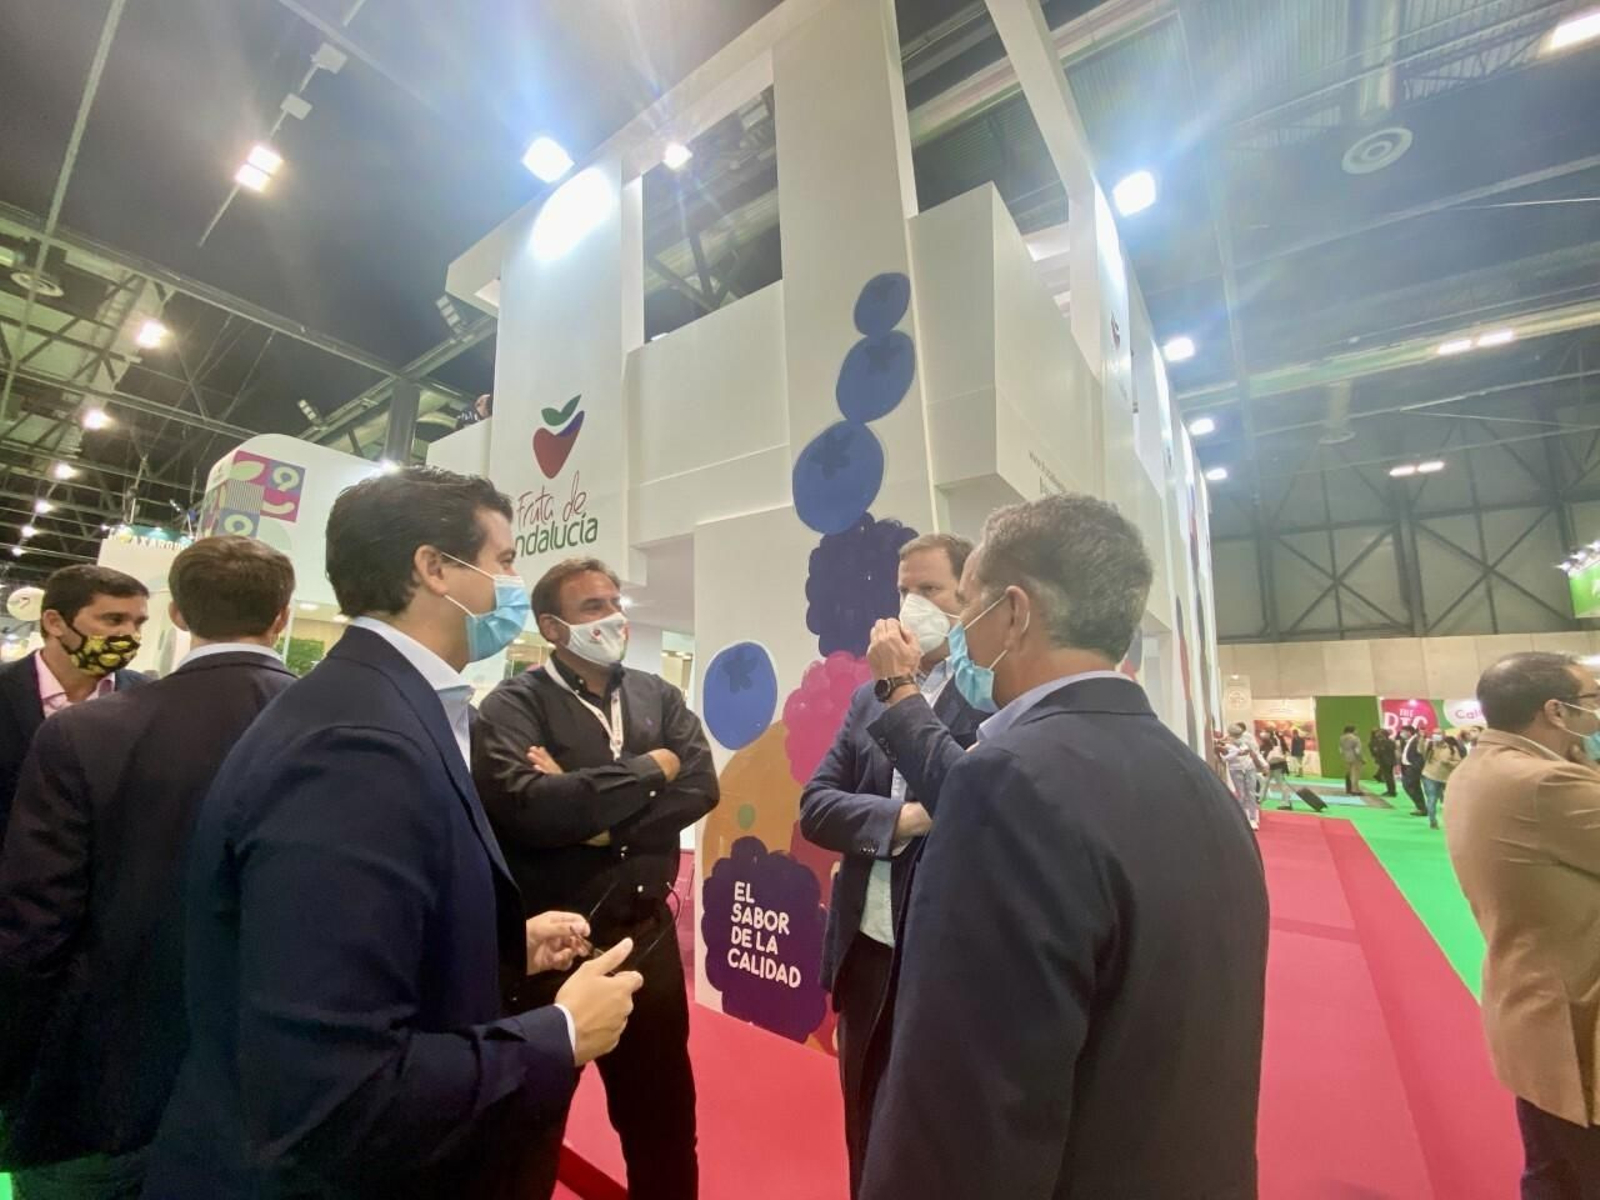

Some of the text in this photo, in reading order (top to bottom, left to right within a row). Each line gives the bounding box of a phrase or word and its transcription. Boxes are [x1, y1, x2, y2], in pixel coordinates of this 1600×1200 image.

[516, 470, 587, 532] Fruta de
[515, 511, 598, 557] ndalucía
[734, 881, 755, 904] EL
[730, 902, 790, 935] SABOR
[731, 925, 778, 955] DE LA
[727, 947, 802, 988] CALIDAD
